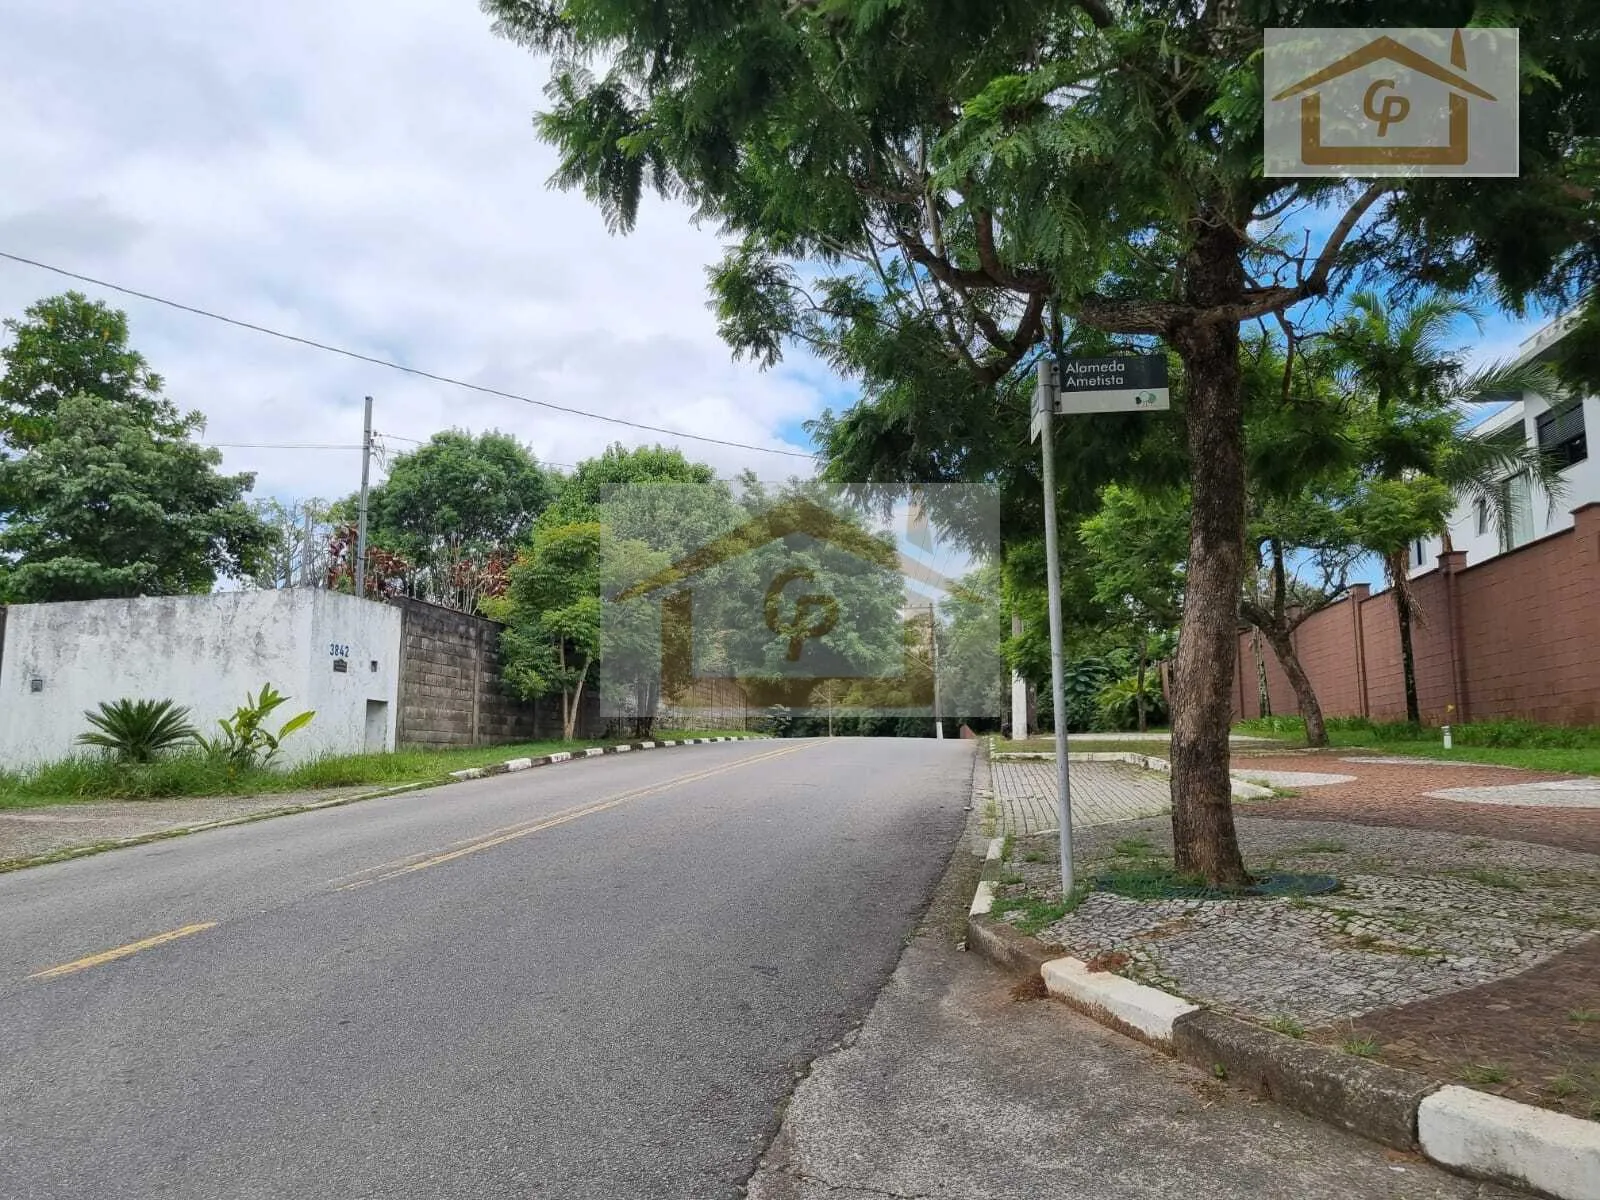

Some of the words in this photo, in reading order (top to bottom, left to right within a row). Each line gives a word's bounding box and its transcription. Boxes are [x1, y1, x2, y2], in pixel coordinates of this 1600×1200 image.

[1065, 360, 1125, 374] Alameda
[1066, 374, 1124, 387] Ametista
[329, 643, 350, 658] 3842
